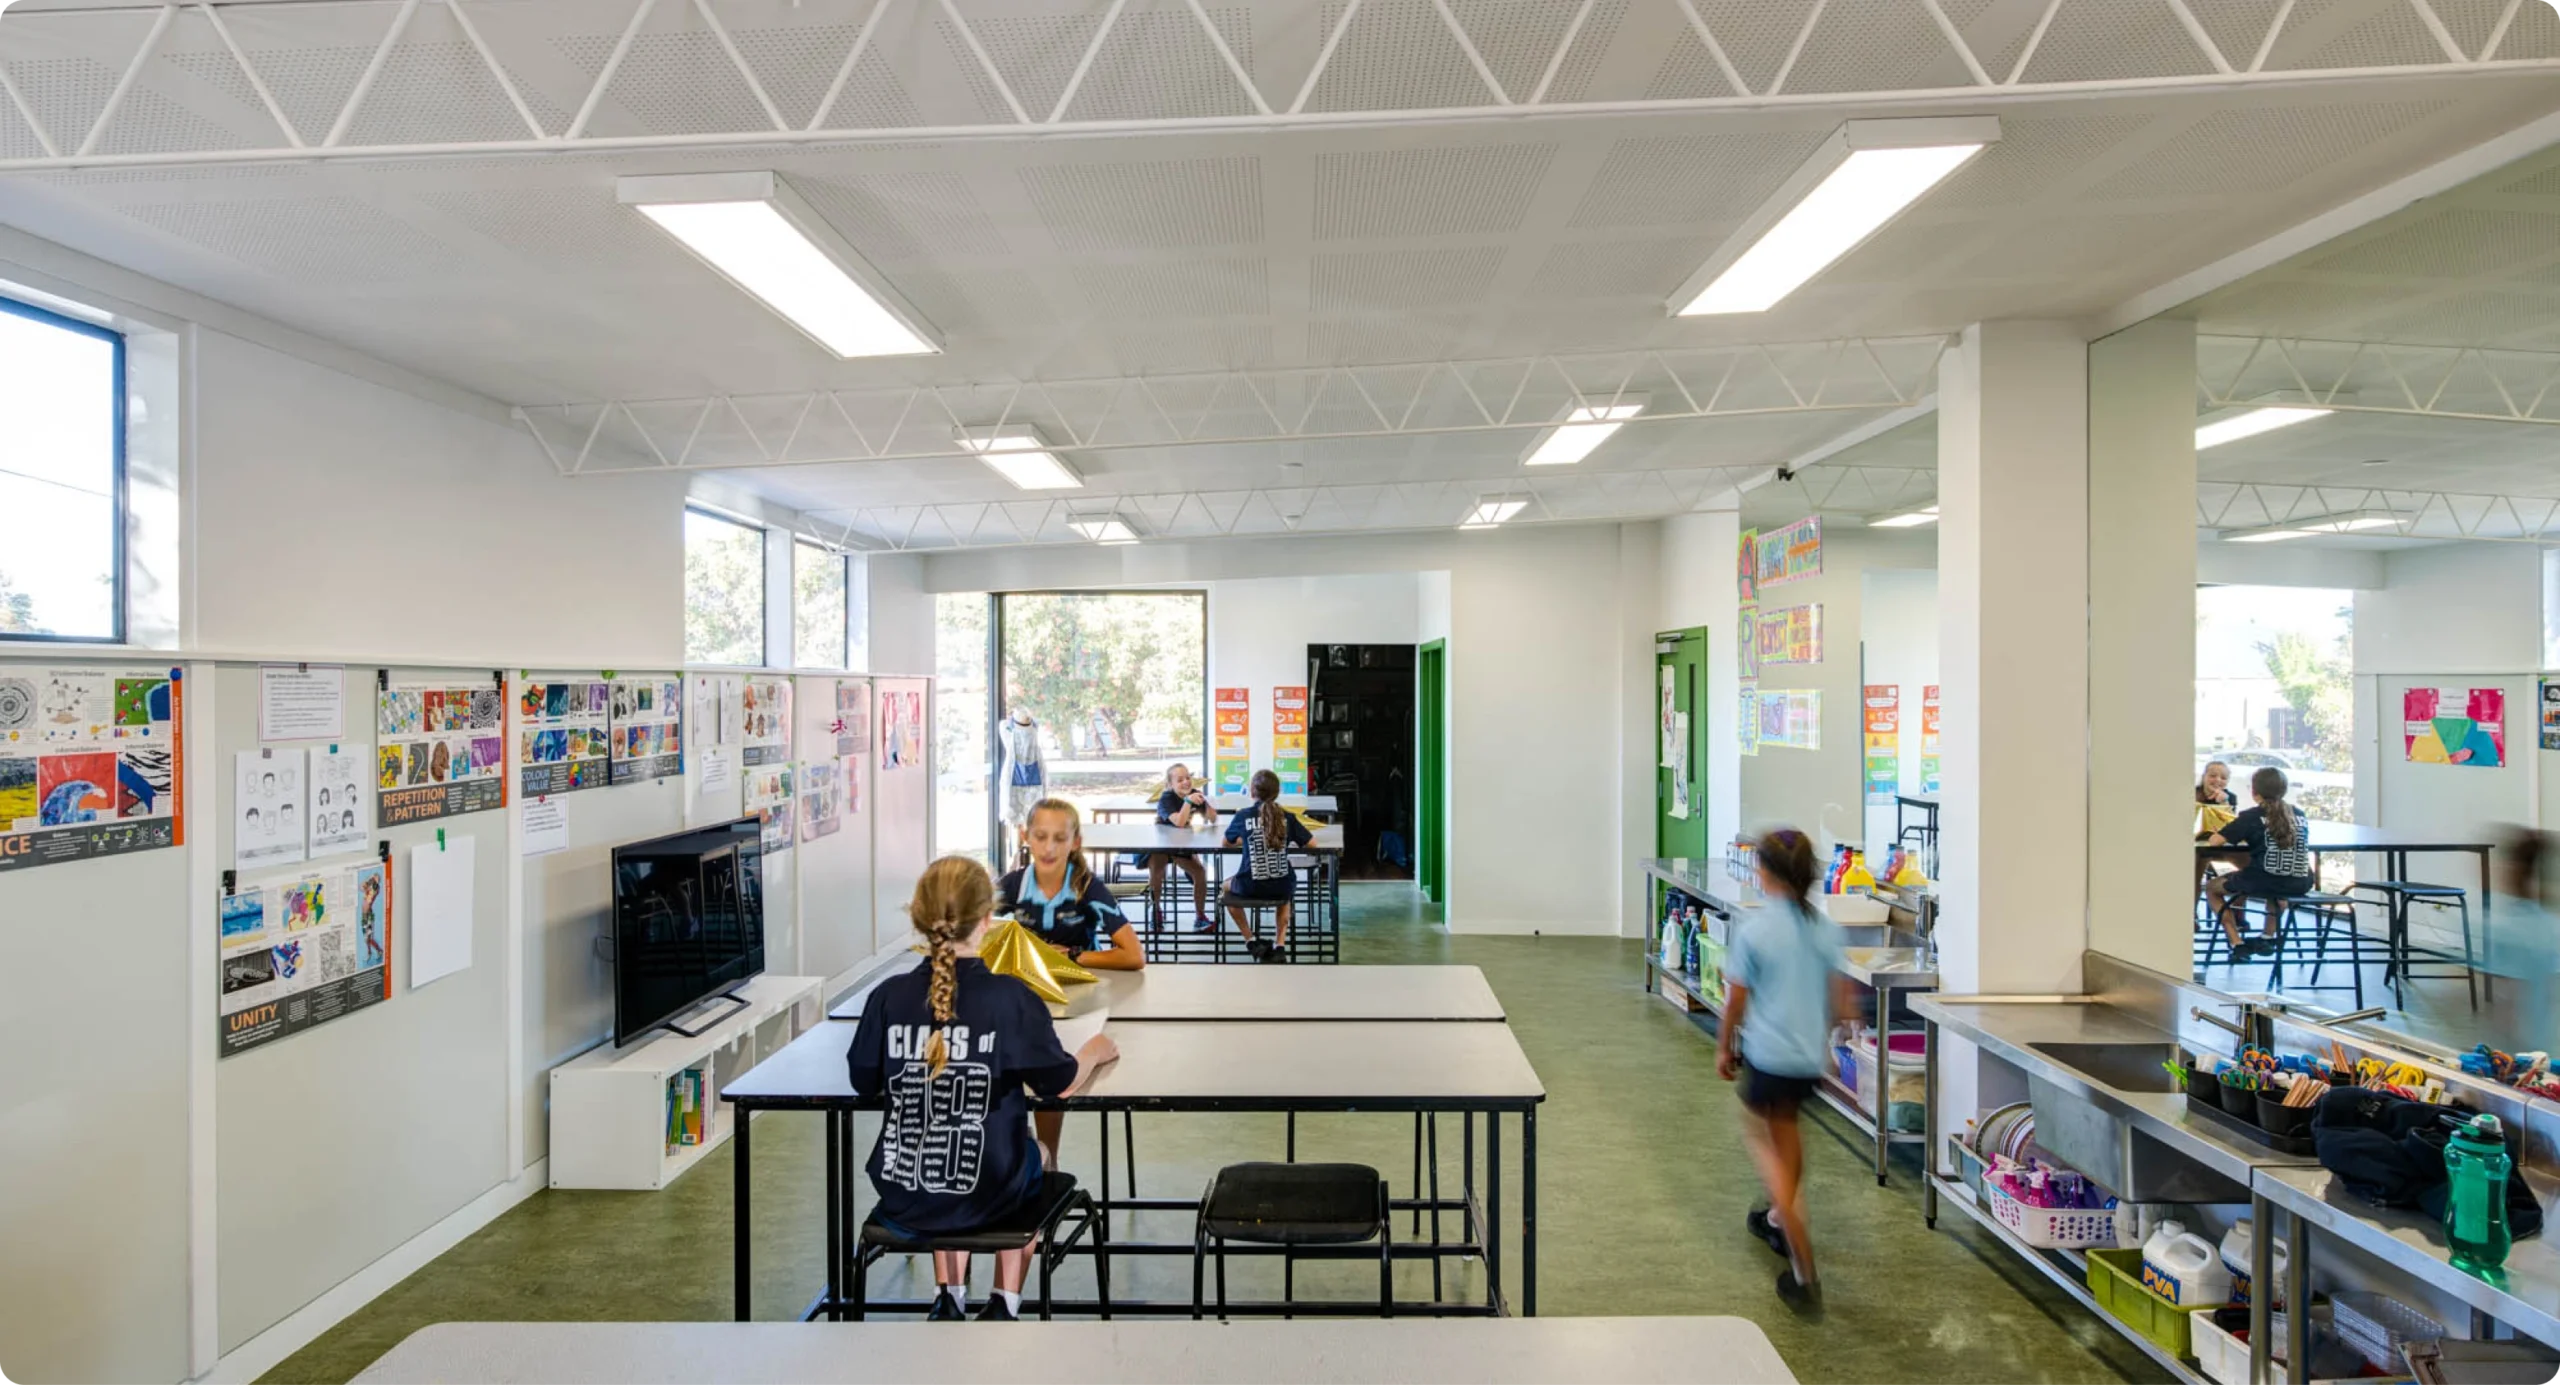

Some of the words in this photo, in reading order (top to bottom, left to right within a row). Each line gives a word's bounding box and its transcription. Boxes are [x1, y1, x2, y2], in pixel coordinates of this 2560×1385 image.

[521, 768, 550, 781] COLOUR
[383, 787, 446, 807] REPETITION
[394, 801, 442, 821] PATTERN
[230, 1003, 278, 1031] UNITY
[978, 1031, 996, 1053] of
[2143, 1266, 2176, 1302] PVA
